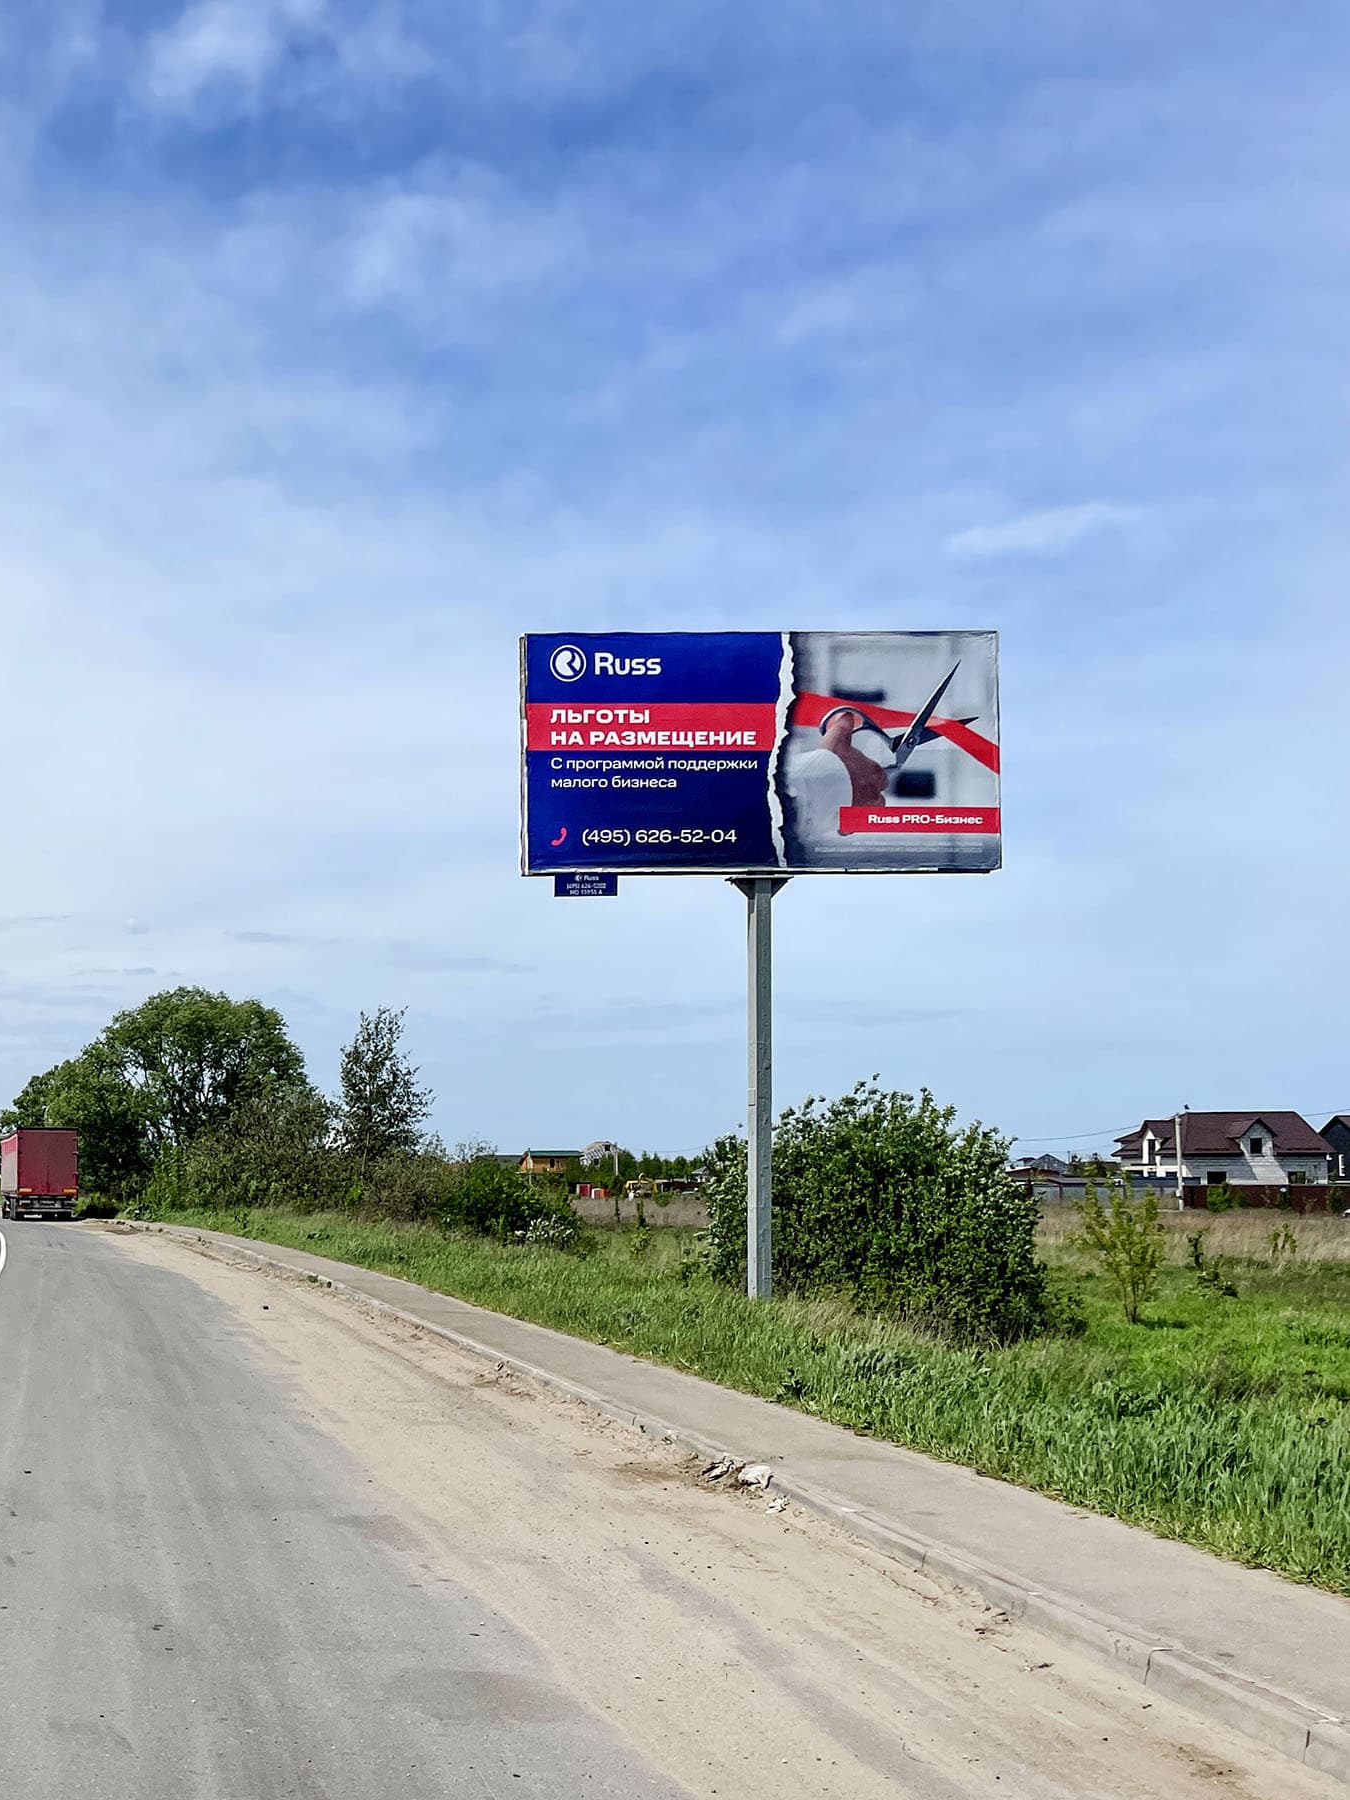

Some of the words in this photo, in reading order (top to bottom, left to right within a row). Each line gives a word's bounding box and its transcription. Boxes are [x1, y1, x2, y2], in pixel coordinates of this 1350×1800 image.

[594, 652, 662, 675] Russ
[550, 708, 650, 724] ЛЬГОТЫ
[550, 731, 584, 746] НА
[589, 730, 757, 747] РАЗМЕЩЕНИЕ
[551, 758, 563, 770] С
[566, 756, 664, 772] программой
[667, 758, 758, 772] поддержки
[551, 777, 608, 788] малого
[612, 775, 677, 788] бизнеса
[867, 815, 900, 824] Russ
[902, 814, 983, 825] PRO-Бизнес
[582, 828, 631, 846] (495)
[635, 829, 737, 844] 626-52-04
